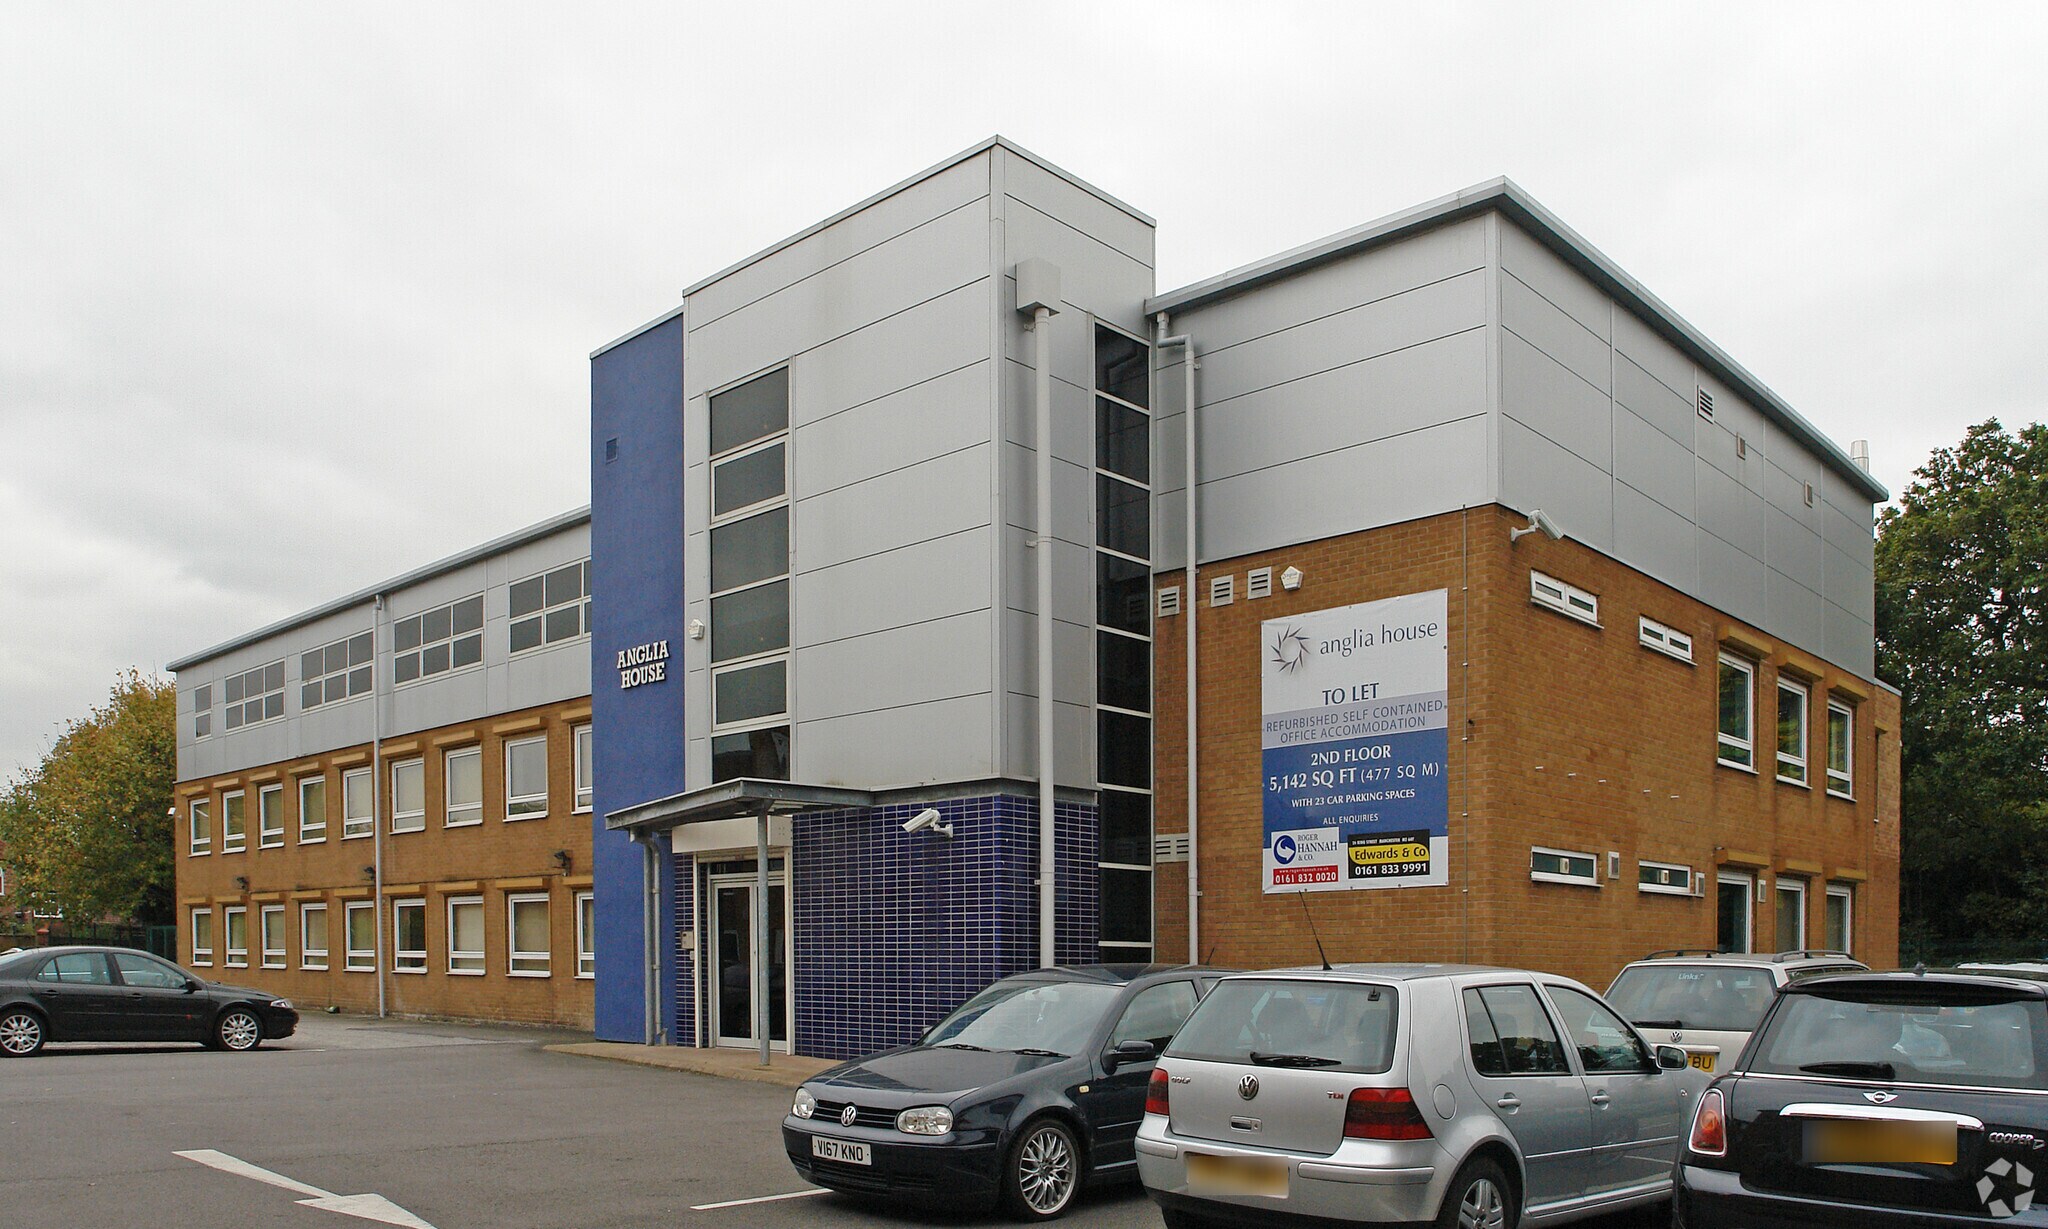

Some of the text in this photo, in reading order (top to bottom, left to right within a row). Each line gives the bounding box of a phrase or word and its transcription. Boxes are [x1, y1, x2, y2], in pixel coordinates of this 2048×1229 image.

[1320, 622, 1438, 657] anglia house
[617, 640, 669, 668] ANGLIA
[621, 662, 665, 688] HOUSE
[1322, 682, 1380, 706] TO LET
[1266, 700, 1442, 732] REFURBISHED SELF CONTAINED
[1280, 716, 1426, 743] OFFICE ACCOMMODATION
[1311, 745, 1391, 766] 2ND FLOOR
[1269, 762, 1439, 793] 5,142 SQ FT (477 SQ M)
[1292, 789, 1415, 808] WITH 23 CAR PARKING SPACES
[1323, 813, 1378, 825] ALL ENQUIRIES
[1298, 841, 1337, 853] HANNAH
[1355, 847, 1426, 860] Edwards & Co
[1276, 872, 1336, 883] 0161 832 0020
[1355, 863, 1426, 875] 0161 833 9991
[1687, 1055, 1712, 1069] BU
[1171, 1076, 1191, 1084] GOLF
[1989, 1132, 2034, 1144] COOPER
[817, 1140, 863, 1162] V167 KNO
